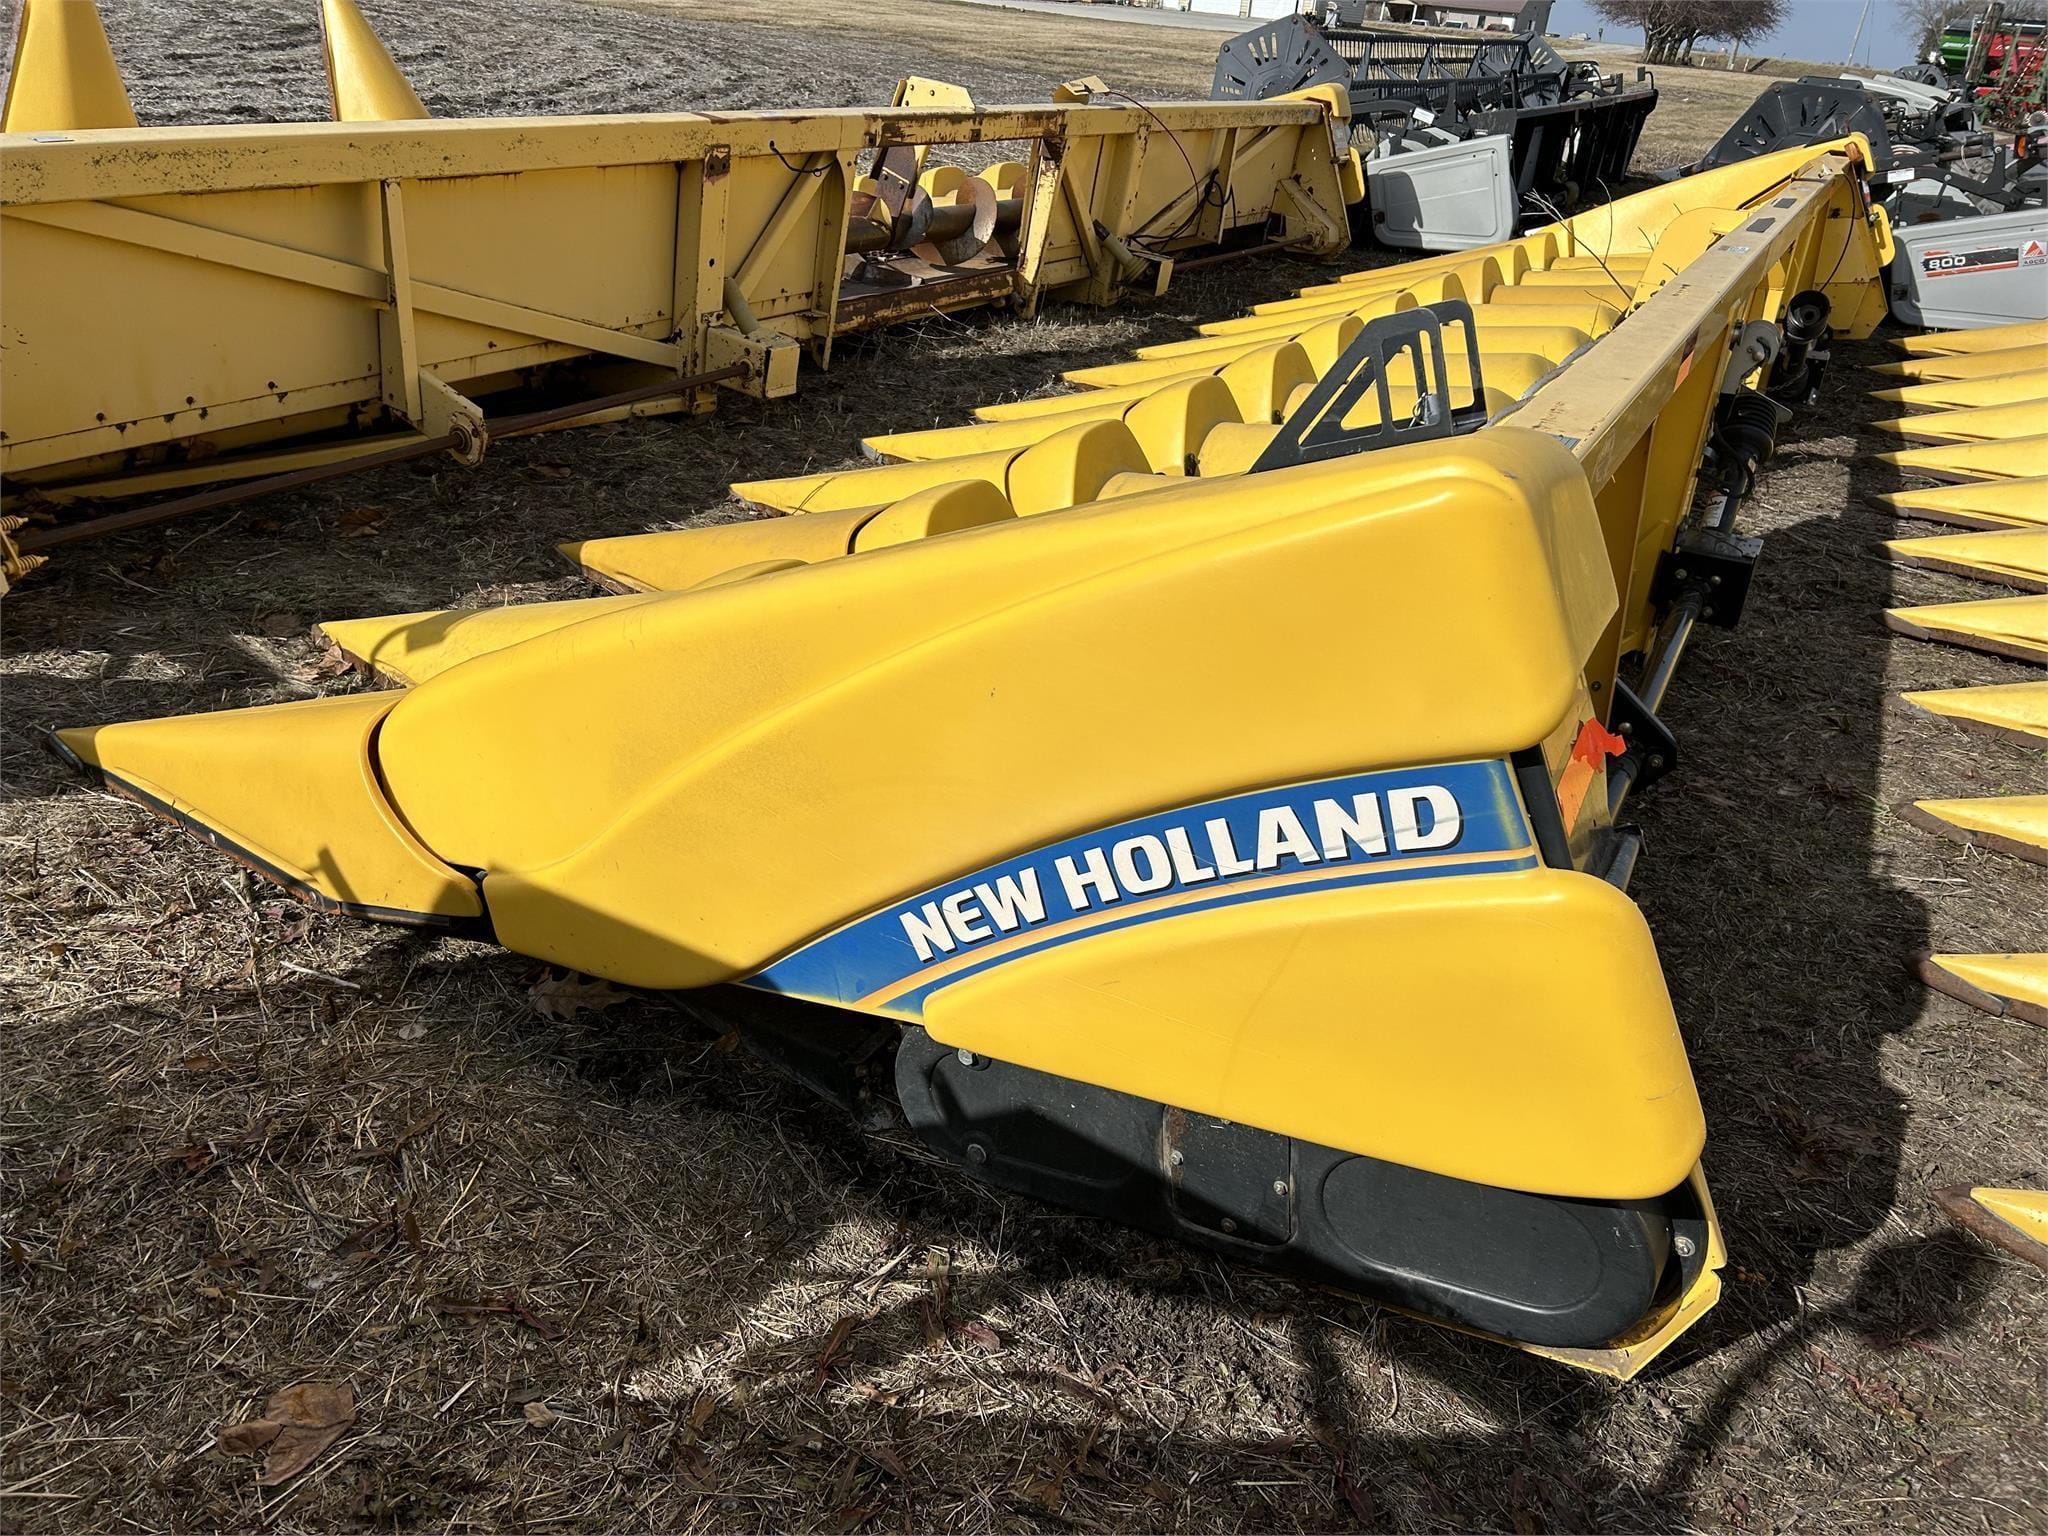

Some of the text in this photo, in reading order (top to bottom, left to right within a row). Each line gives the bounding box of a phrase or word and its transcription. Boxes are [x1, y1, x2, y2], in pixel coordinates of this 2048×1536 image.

[1929, 256, 1966, 269] 800
[899, 785, 1462, 963] NEW HOLLAND
